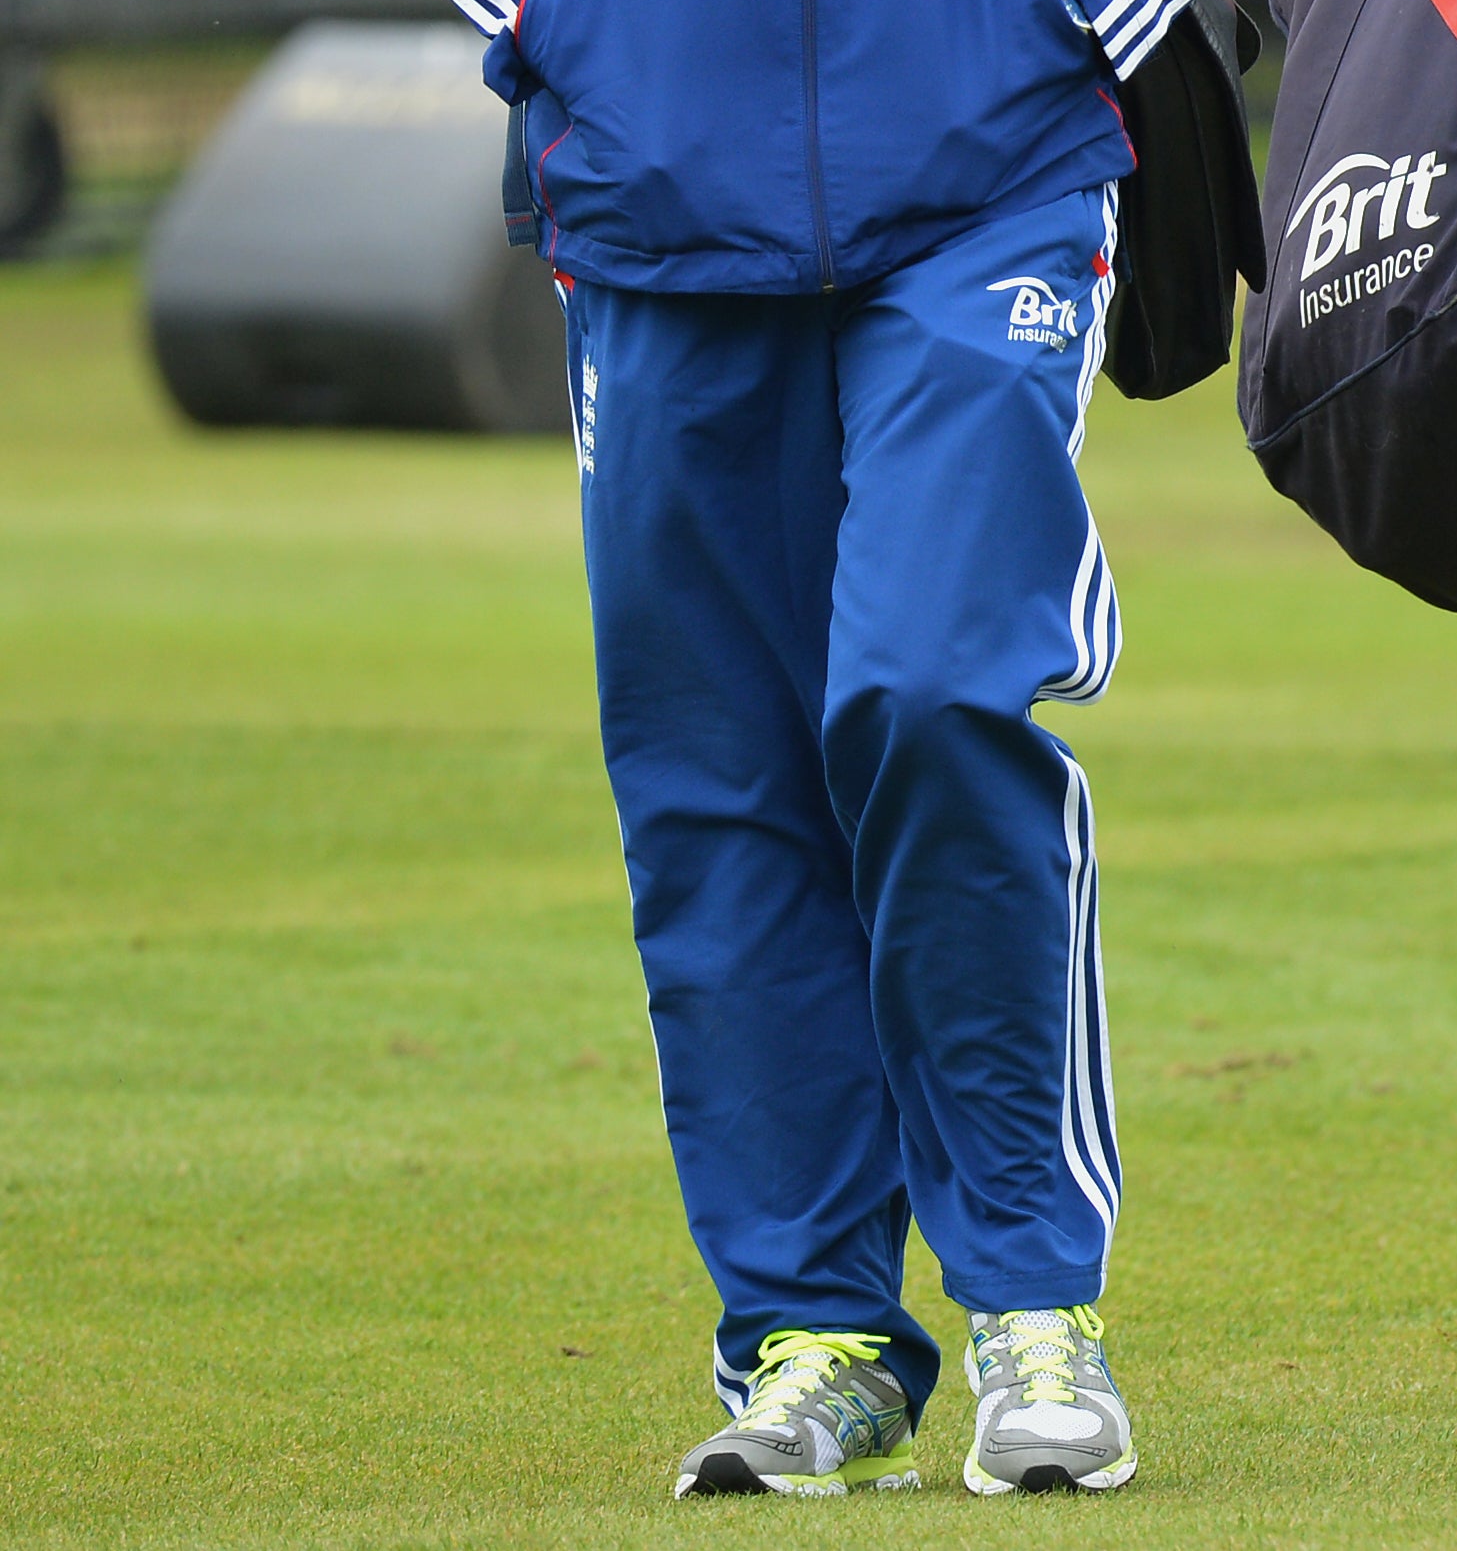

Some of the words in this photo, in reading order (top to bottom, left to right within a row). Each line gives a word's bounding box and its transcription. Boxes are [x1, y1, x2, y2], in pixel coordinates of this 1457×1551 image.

[1300, 150, 1448, 282] Brit
[1009, 286, 1078, 338] Brit
[1300, 243, 1434, 329] Insurance
